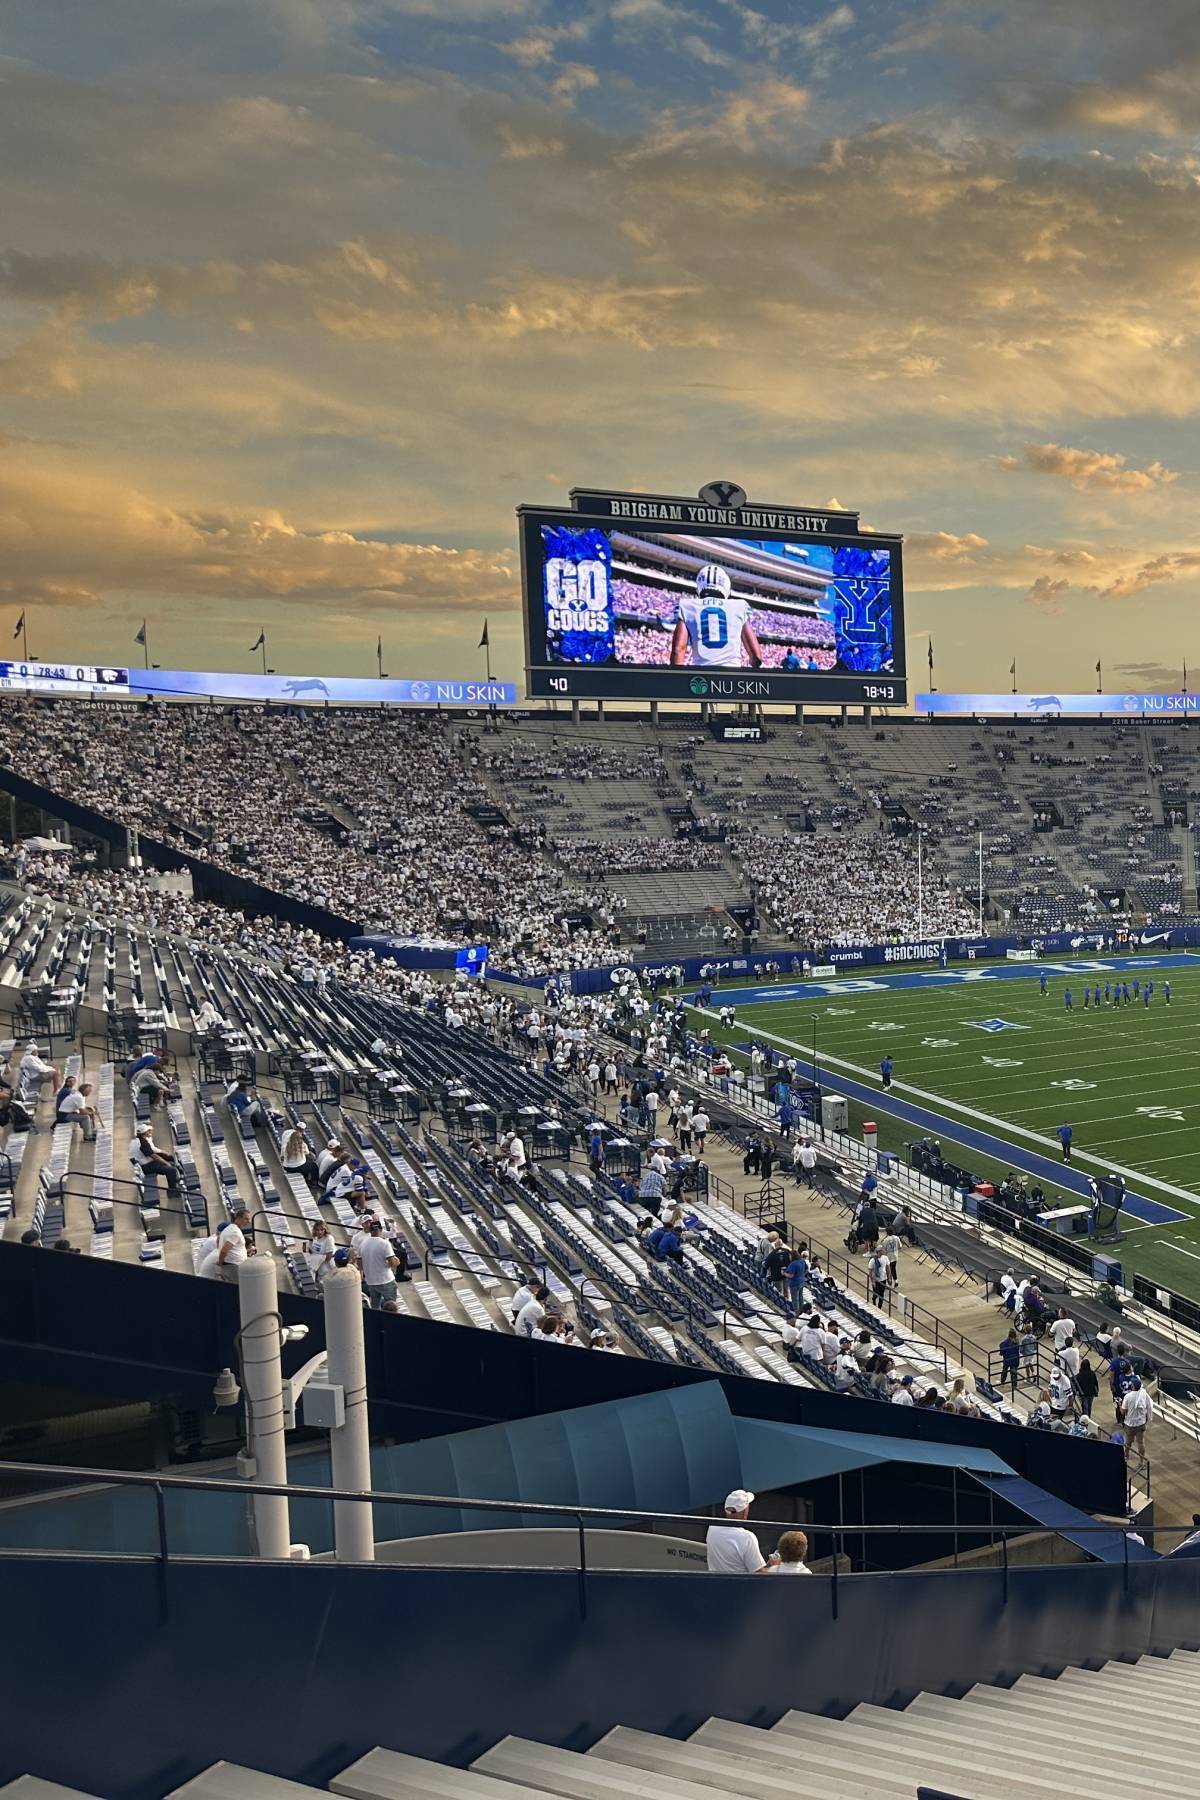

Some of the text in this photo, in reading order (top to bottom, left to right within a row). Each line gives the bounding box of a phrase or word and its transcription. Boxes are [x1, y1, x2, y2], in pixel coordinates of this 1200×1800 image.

[610, 501, 829, 532] BRIGHAM YOUNG UNIVERSITY
[545, 558, 608, 609] GO
[547, 610, 609, 632] COUGS
[20, 665, 28, 678] 0
[39, 667, 65, 679] 78:43
[76, 668, 84, 680] 0
[549, 677, 568, 692] 40
[711, 680, 770, 695] NU SKIN
[437, 685, 505, 700] NU SKIN
[863, 685, 893, 699] 78:43
[1143, 697, 1197, 709] NU SKIN
[724, 727, 760, 738] ESPN
[830, 951, 863, 961] crumbl
[884, 944, 940, 961] #GOCOUGS
[1051, 1078, 1098, 1090] 50
[1135, 1106, 1183, 1118] 40
